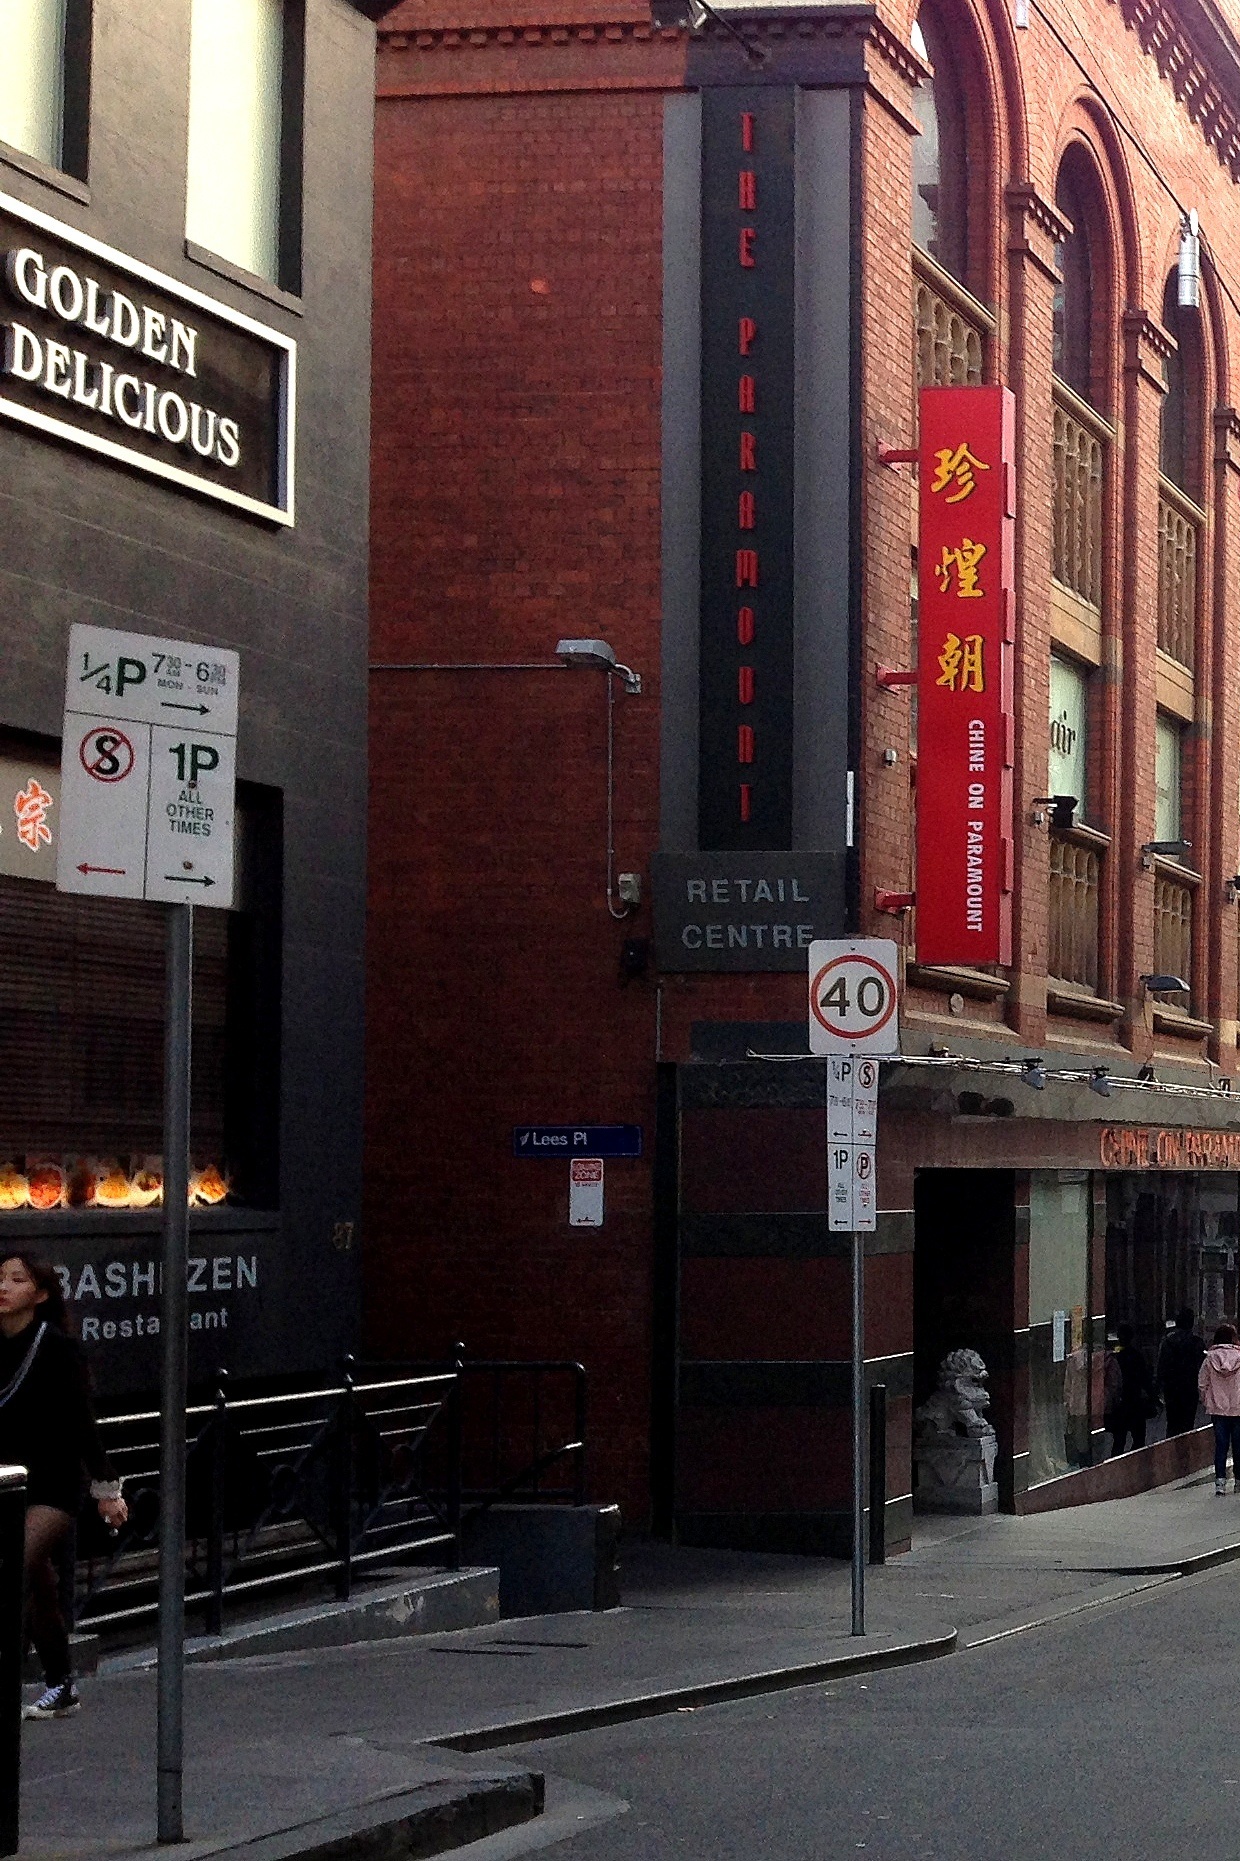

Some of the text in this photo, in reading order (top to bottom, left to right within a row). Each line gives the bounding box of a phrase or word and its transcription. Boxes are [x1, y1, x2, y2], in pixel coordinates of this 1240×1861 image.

[739, 111, 757, 269] THE
[14, 247, 198, 378] GOLDEN
[10, 321, 241, 467] DELICIOUS
[735, 317, 758, 823] PARAMOUNT
[169, 743, 220, 782] 1P
[166, 803, 214, 821] OTHER
[179, 790, 202, 804] ALL
[169, 822, 212, 837] TIMES
[967, 719, 985, 933] CHINE ON PARAMOUNT
[686, 878, 810, 904] RETAIL
[681, 923, 815, 950] CENTRE
[820, 976, 885, 1018] 40
[533, 1131, 588, 1146] Lees Pl
[187, 1256, 258, 1293] ZEN
[82, 1306, 229, 1341] Restaant
